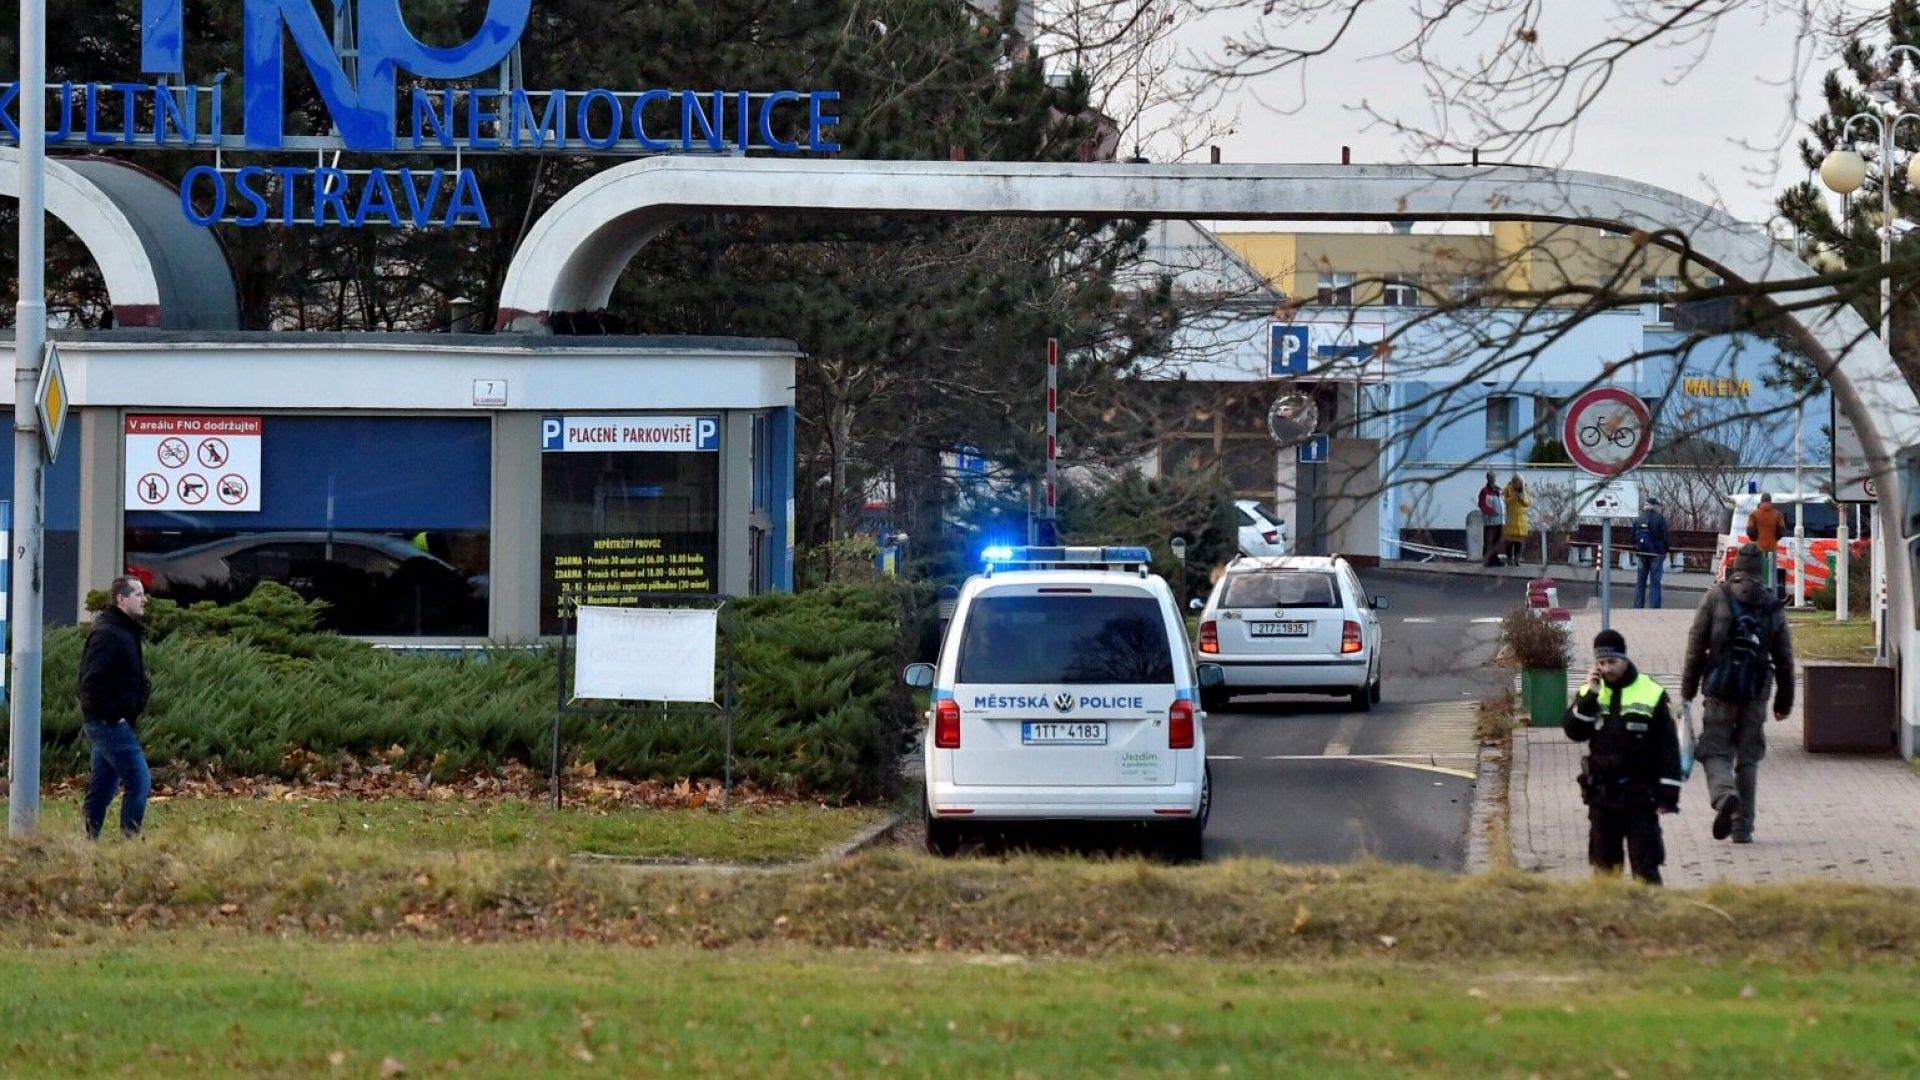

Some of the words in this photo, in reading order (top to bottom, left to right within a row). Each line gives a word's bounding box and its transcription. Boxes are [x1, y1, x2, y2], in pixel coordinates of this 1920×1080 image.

[412, 89, 840, 151] NEMOCNICE
[181, 166, 490, 229] OSTRAVA
[1282, 334, 1300, 367] P
[487, 383, 493, 394] 7
[129, 421, 137, 429] V
[140, 420, 174, 430] areálu
[177, 421, 201, 430] FNO
[203, 420, 258, 432] dodržujte!
[542, 420, 561, 448] P
[569, 424, 617, 442] PLACENÉ
[623, 424, 691, 443] PARKOVIŠTĚ
[698, 420, 716, 448] P
[635, 539, 661, 549] PROVOZ
[555, 556, 582, 566] ZDARMA
[555, 570, 582, 579] ZDARMA
[974, 692, 1049, 709] MĚSTSKÁ
[1080, 697, 1143, 709] POLICIE
[1035, 724, 1057, 738] 1TT
[1068, 724, 1100, 739] 4183
